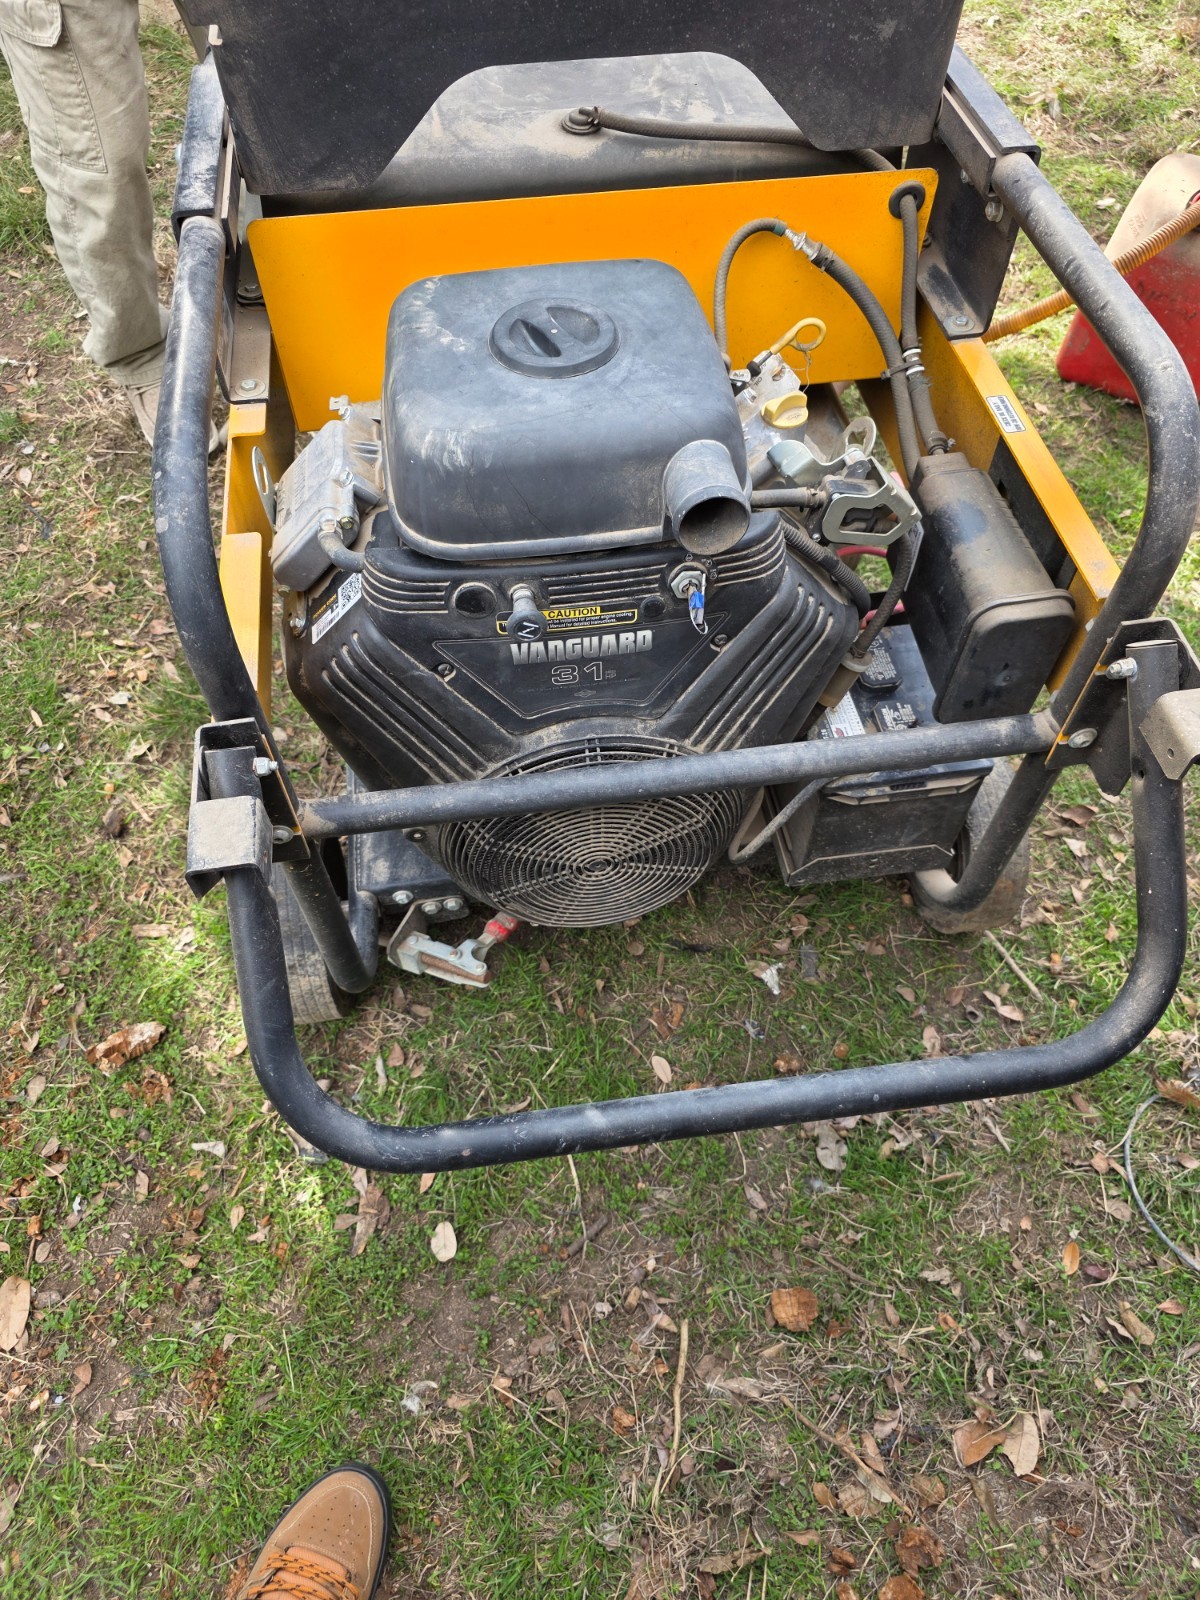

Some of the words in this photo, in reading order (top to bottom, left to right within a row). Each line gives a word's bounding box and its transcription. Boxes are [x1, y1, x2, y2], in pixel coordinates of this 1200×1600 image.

[548, 607, 598, 618] CAUTION
[510, 630, 653, 665] VANGUARD
[552, 661, 603, 685] 31
